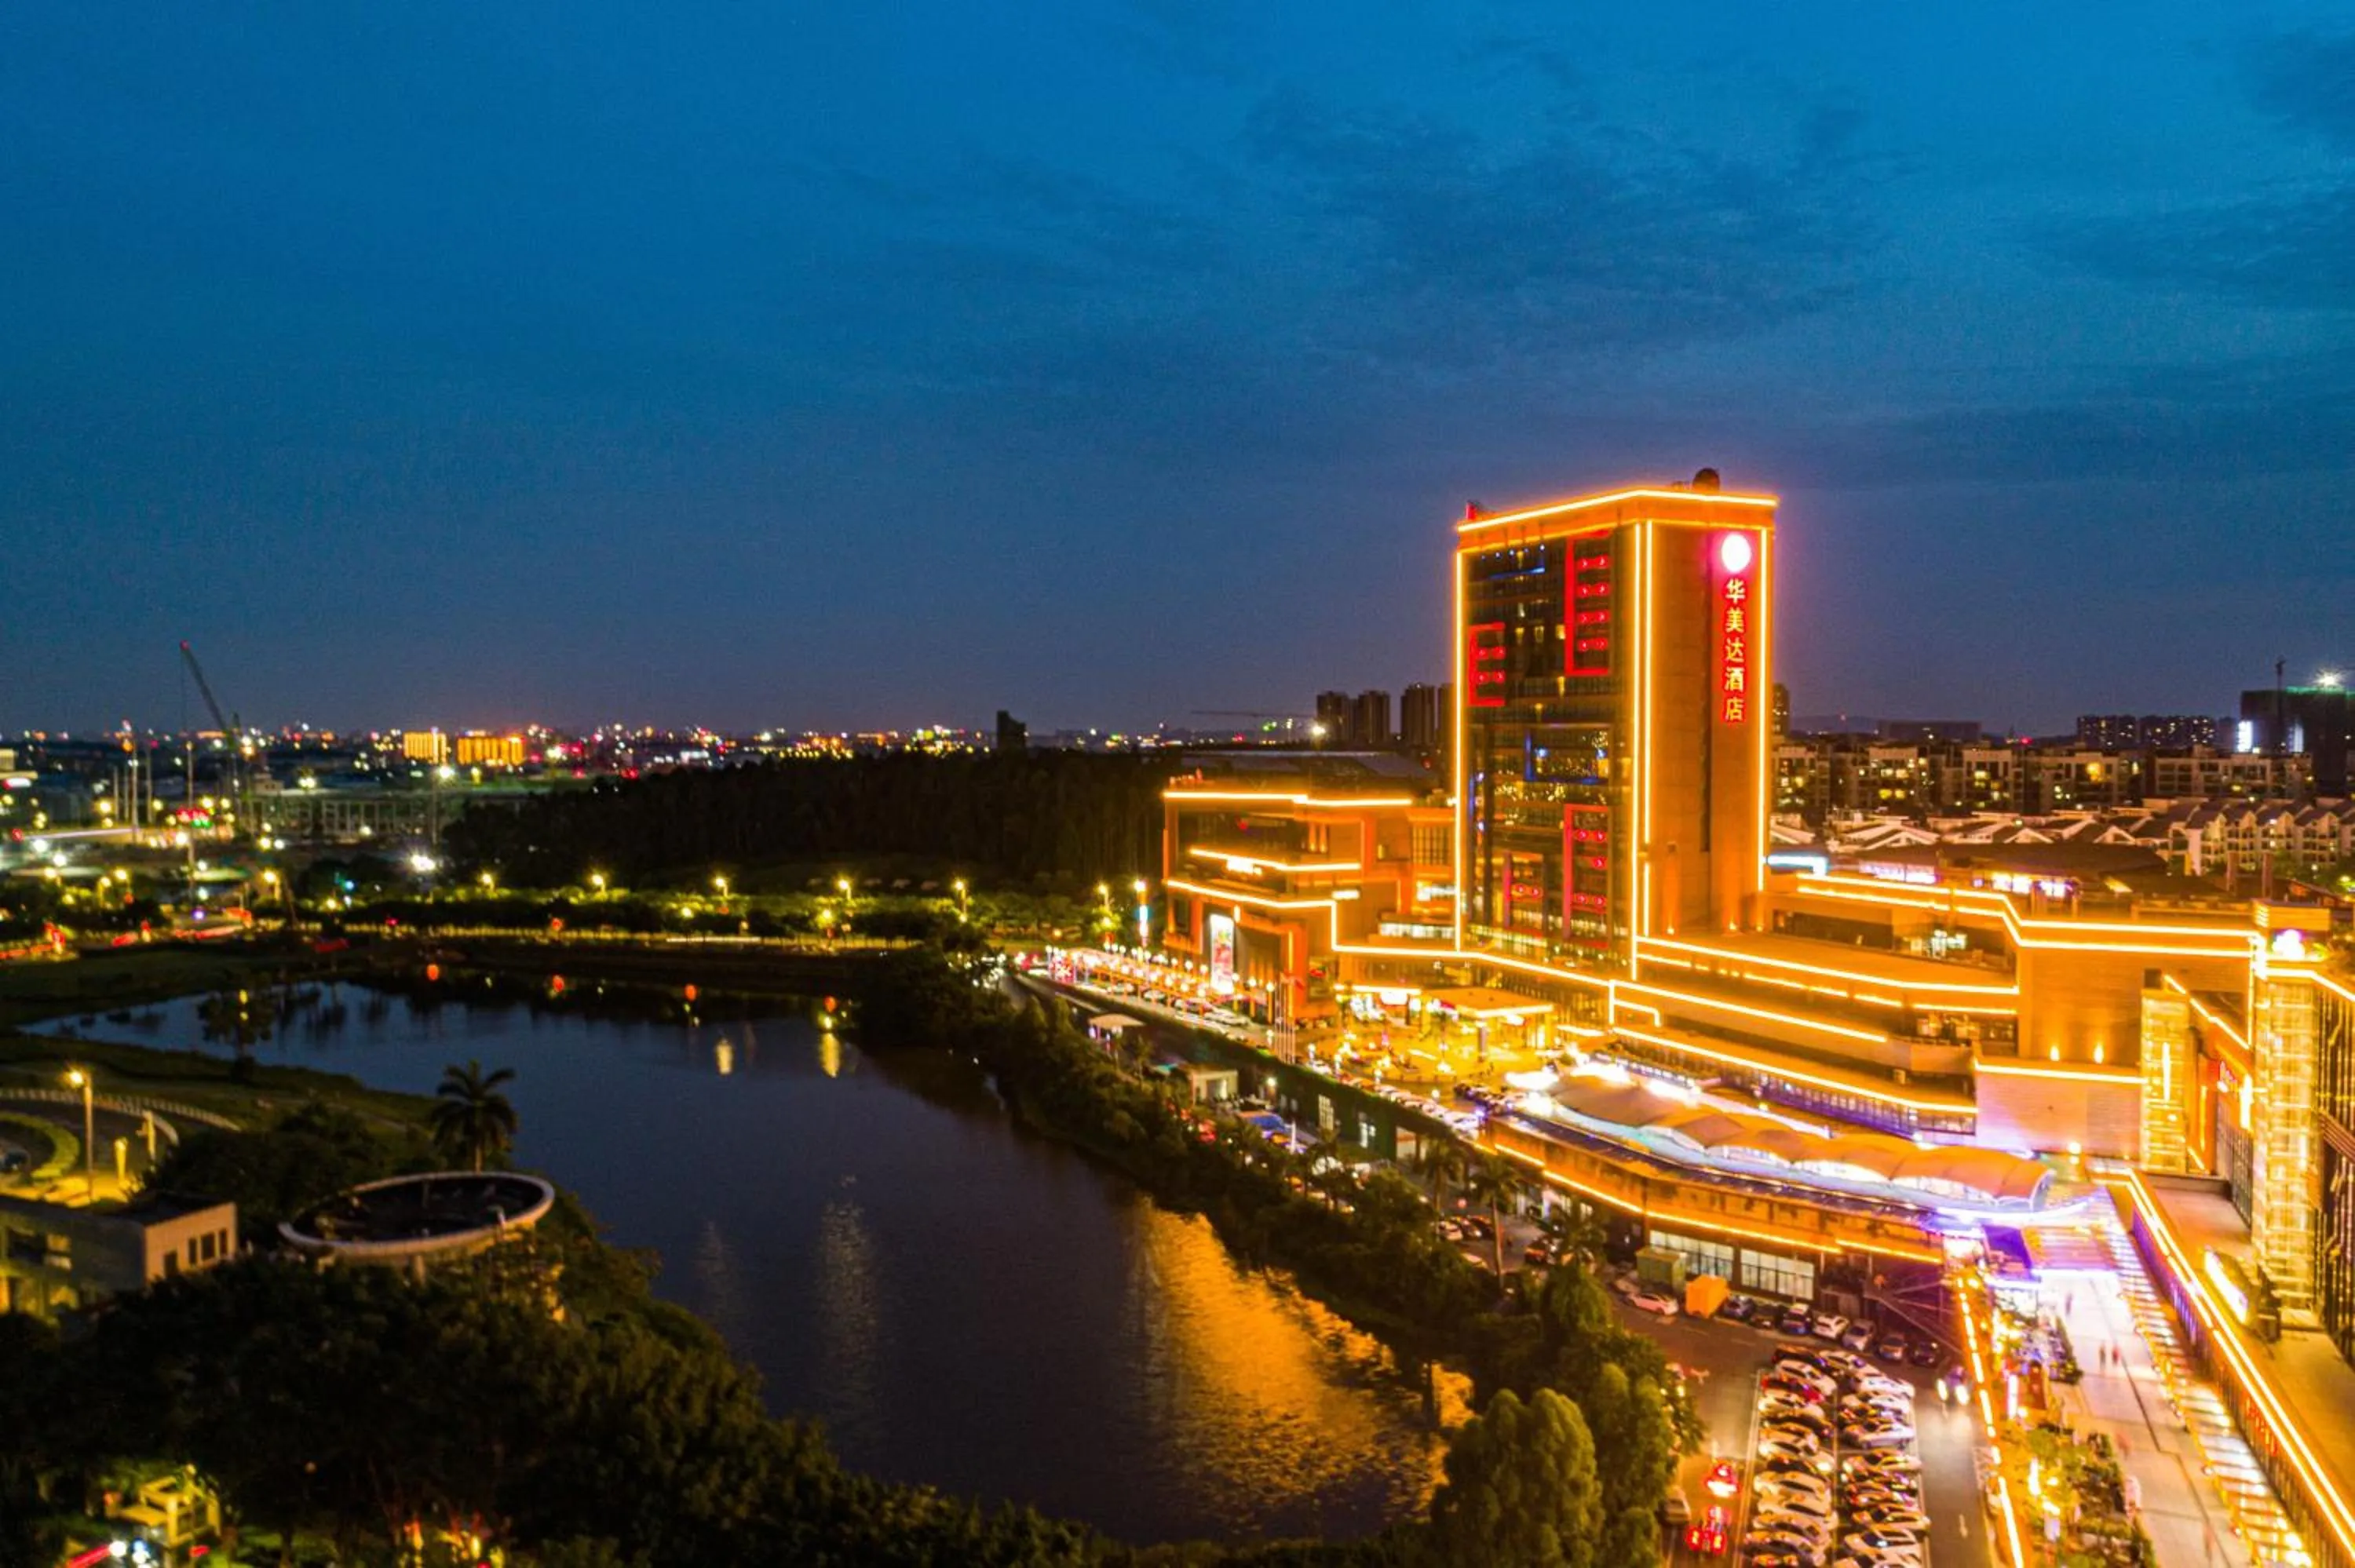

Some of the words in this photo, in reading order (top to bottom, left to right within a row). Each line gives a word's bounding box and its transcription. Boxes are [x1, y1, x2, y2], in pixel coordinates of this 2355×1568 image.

[1724, 577, 1746, 722] 华美达酒店
